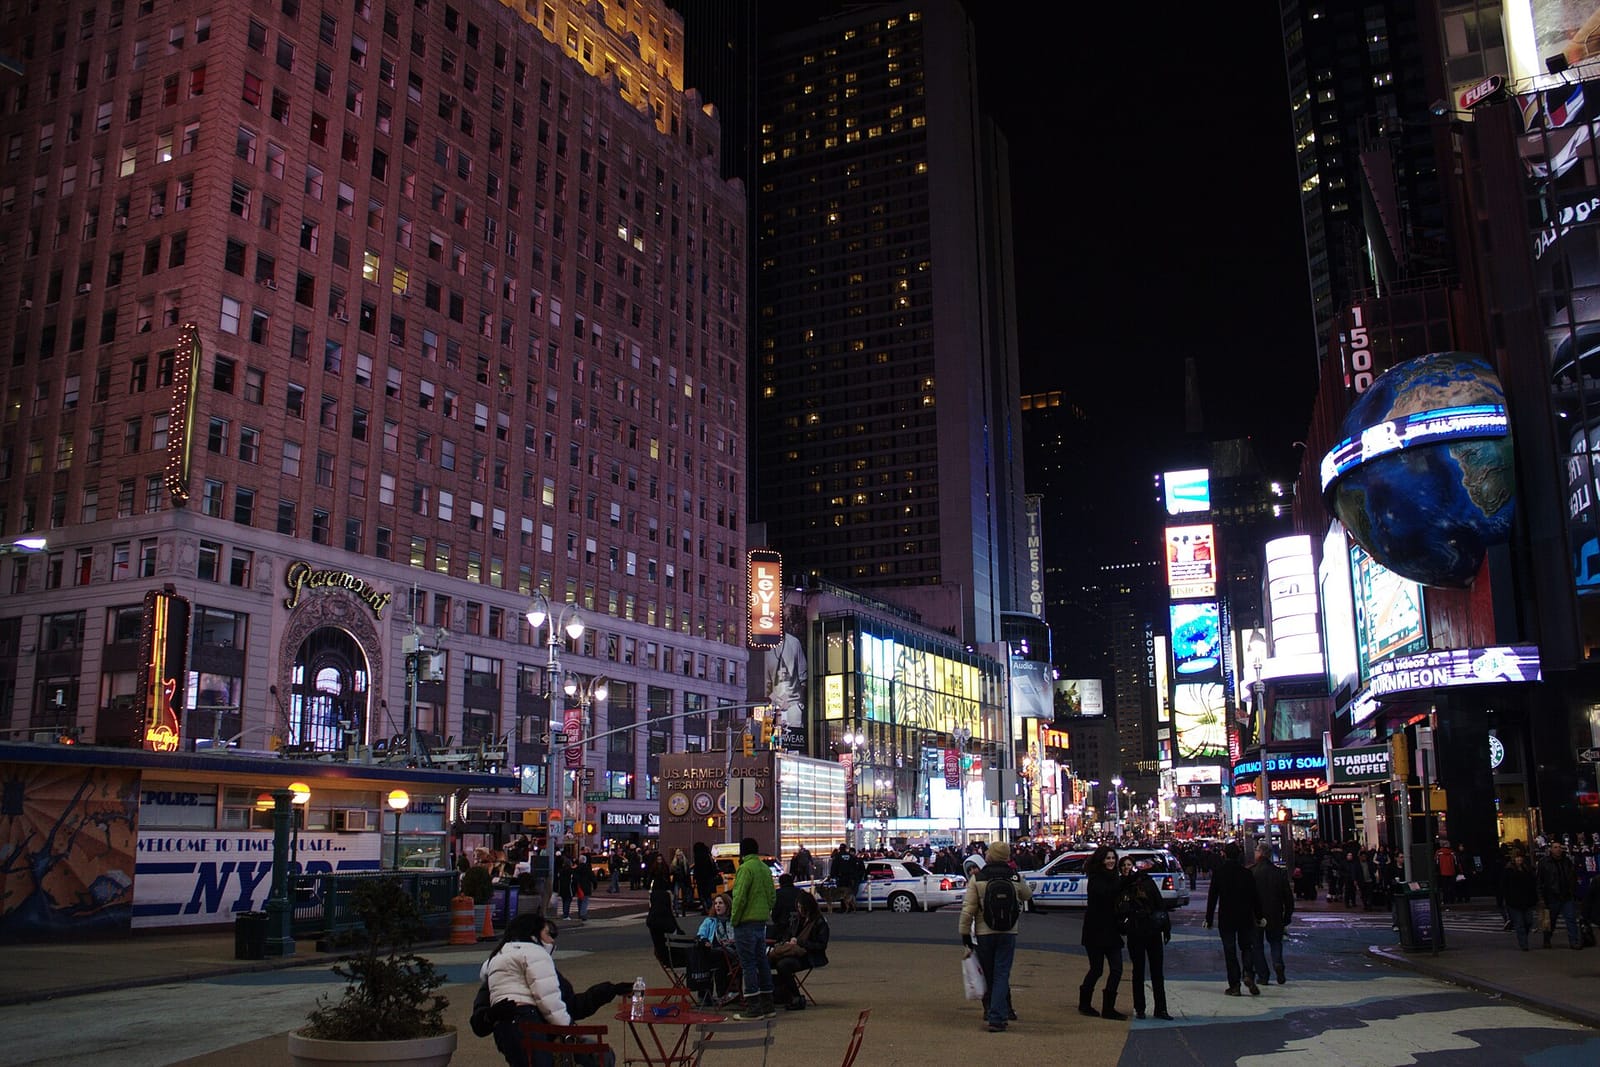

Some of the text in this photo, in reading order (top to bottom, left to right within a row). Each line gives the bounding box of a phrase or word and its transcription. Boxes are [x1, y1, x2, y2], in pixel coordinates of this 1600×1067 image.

[1466, 80, 1495, 105] FUEL
[1351, 307, 1373, 394] 1500
[1026, 512, 1043, 616] TIMES SQU
[287, 561, 391, 620] Paramount
[1145, 630, 1155, 687] NOVOTEL
[1396, 657, 1426, 671] videos
[1428, 656, 1440, 666] at
[1013, 662, 1033, 670] Audio
[1278, 758, 1293, 770] BY
[1334, 752, 1389, 766] STARBUCK
[683, 767, 724, 779] ARMED
[731, 766, 770, 777] ORCES
[1346, 763, 1387, 775] COFFEE
[667, 779, 723, 790] RECRUITING
[149, 790, 198, 806] POLICE
[137, 839, 207, 852] WELCOME
[215, 839, 232, 852] TO
[1042, 882, 1078, 892] NYPD
